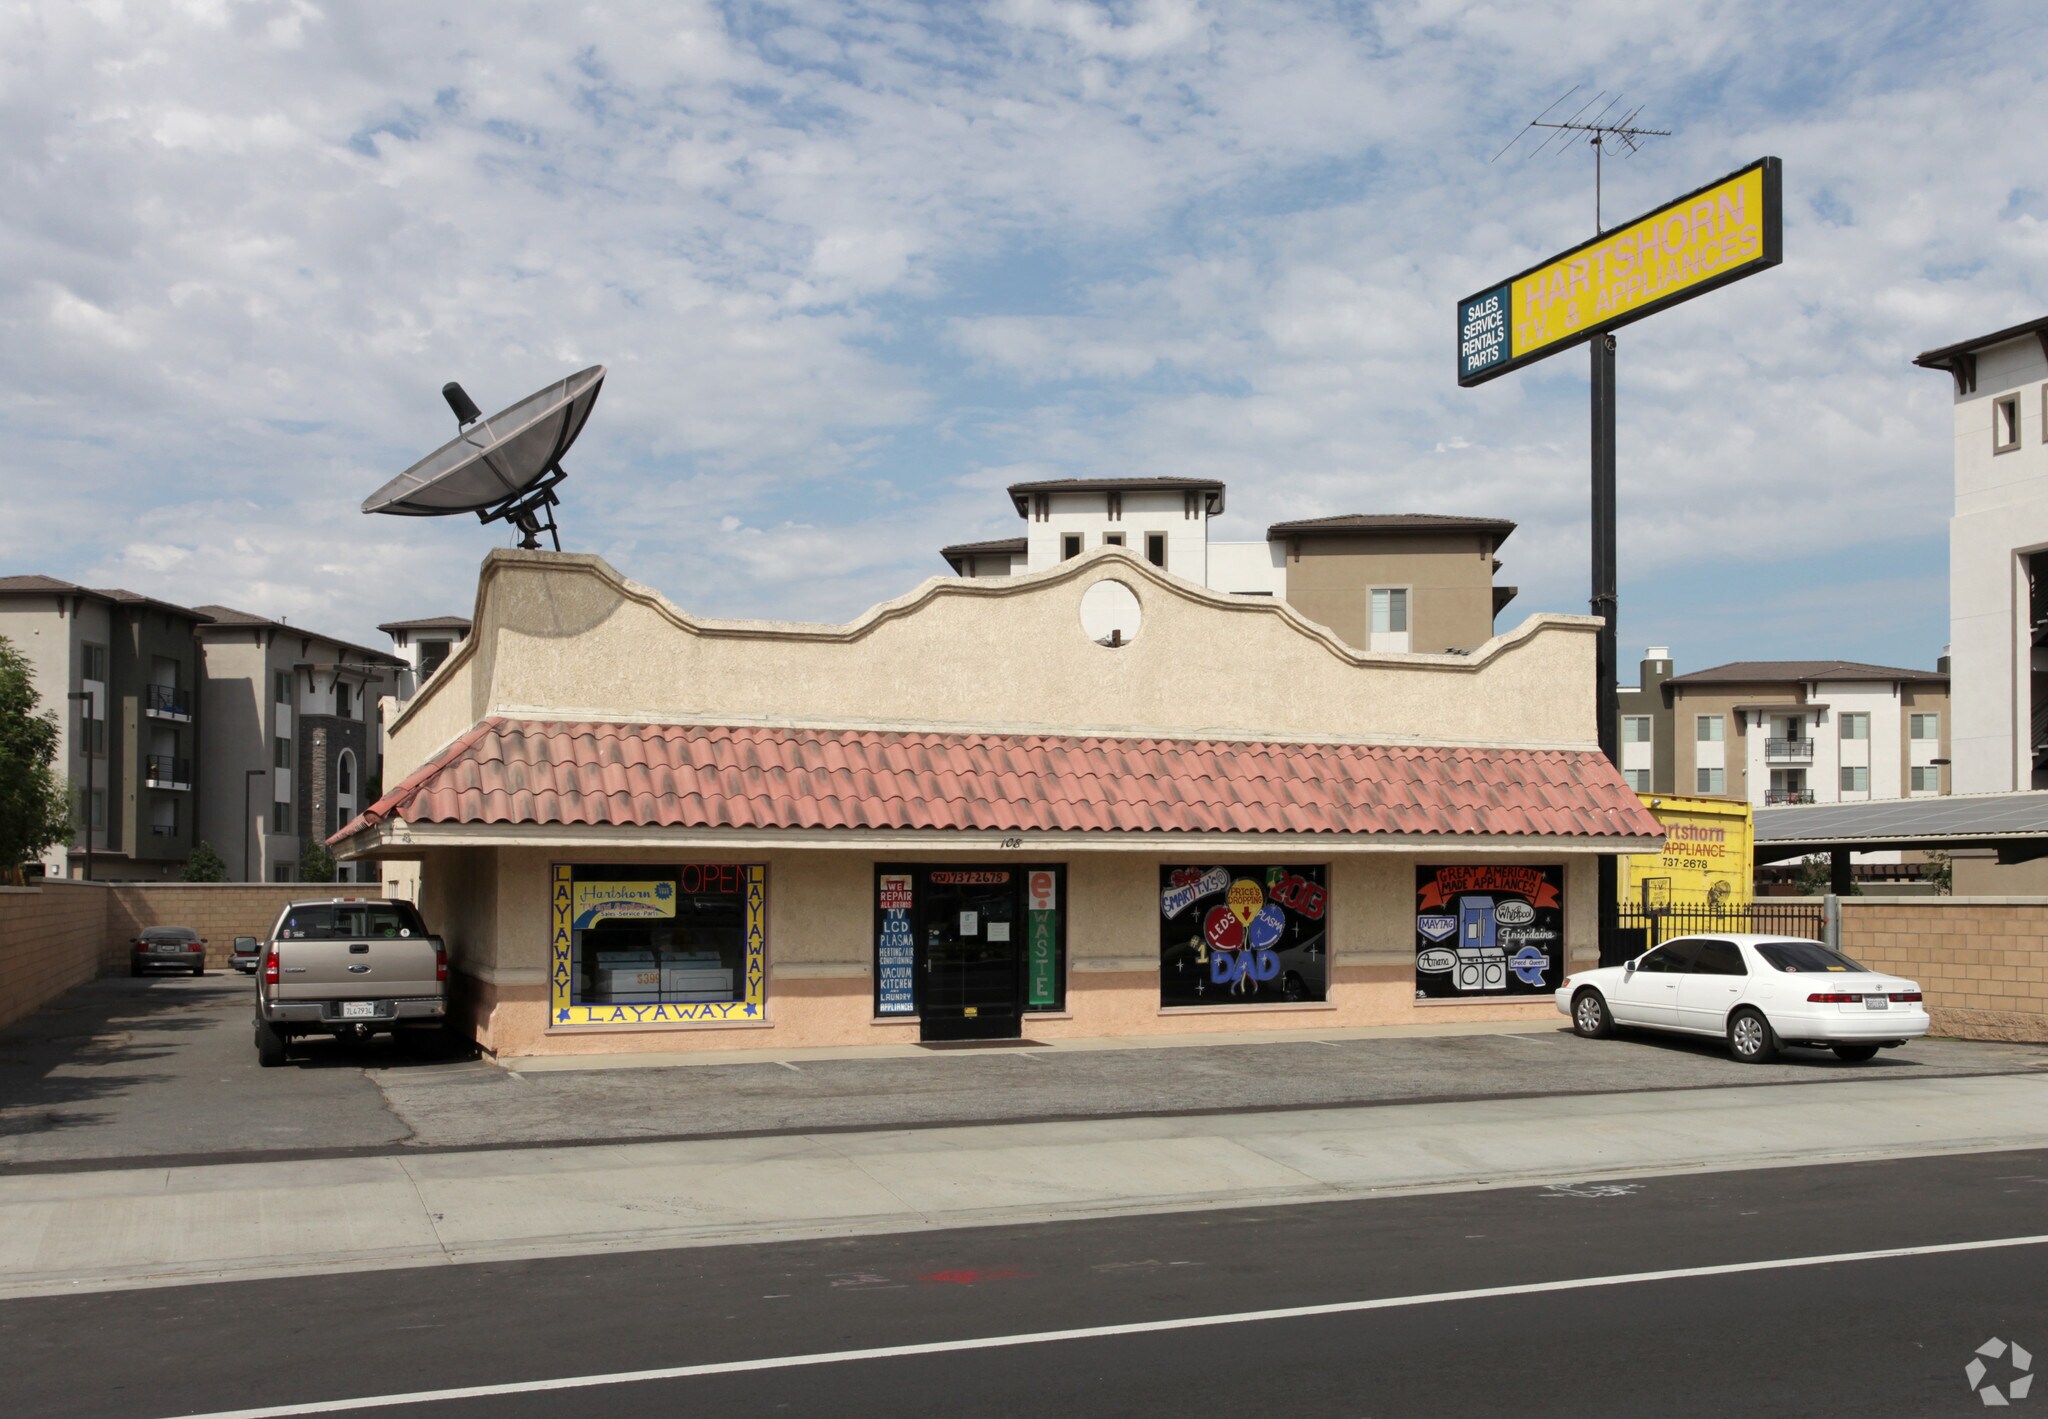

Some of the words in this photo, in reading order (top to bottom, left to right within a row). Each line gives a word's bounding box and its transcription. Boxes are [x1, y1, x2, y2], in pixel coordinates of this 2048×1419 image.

[1525, 185, 1746, 317] HARTSHORN
[1516, 312, 1551, 347] T.V.
[1566, 302, 1580, 328] &
[1595, 224, 1758, 316] APPLIANCES
[1468, 296, 1498, 322] SALES
[1464, 310, 1503, 340] SERVICE
[1462, 327, 1504, 357] RENTALS
[1468, 345, 1499, 370] PARTS
[1000, 838, 1022, 849] 108
[1663, 841, 1725, 857] APPLIANCE
[1662, 857, 1708, 869] 737-2678
[682, 864, 746, 893] OPEN
[1440, 867, 1478, 882] GREAT
[1485, 867, 1538, 882] AMERICAN
[580, 884, 651, 902] Hartshorn
[888, 883, 903, 891] WE
[1231, 886, 1261, 897] PRICE'S
[1441, 879, 1468, 894] MADE
[1473, 877, 1536, 893] APPLIANCES
[880, 891, 912, 901] REPAIR
[1162, 886, 1193, 913] SMART
[1269, 869, 1328, 920] 2013
[888, 909, 904, 919] TV
[1256, 909, 1284, 933] PLASMA
[554, 866, 571, 998] LAYAWAY
[747, 867, 764, 997] LAYAWAY
[883, 921, 909, 933] LCD
[1208, 911, 1237, 941] LED'S
[1421, 918, 1455, 930] MAYTAG
[880, 934, 914, 947] PLASMA
[1500, 927, 1554, 944] Frigidaire
[880, 957, 913, 965] CONDITIONING
[1034, 911, 1049, 996] WASTE
[1420, 953, 1450, 968] Amana
[880, 968, 912, 978] VACUUM
[1211, 950, 1281, 984] DAD
[880, 979, 912, 989] KITCHEN
[880, 993, 911, 1001] LAUNDRY
[586, 1003, 738, 1023] LAYAWAY
[880, 1002, 914, 1012] APPLIANCES
